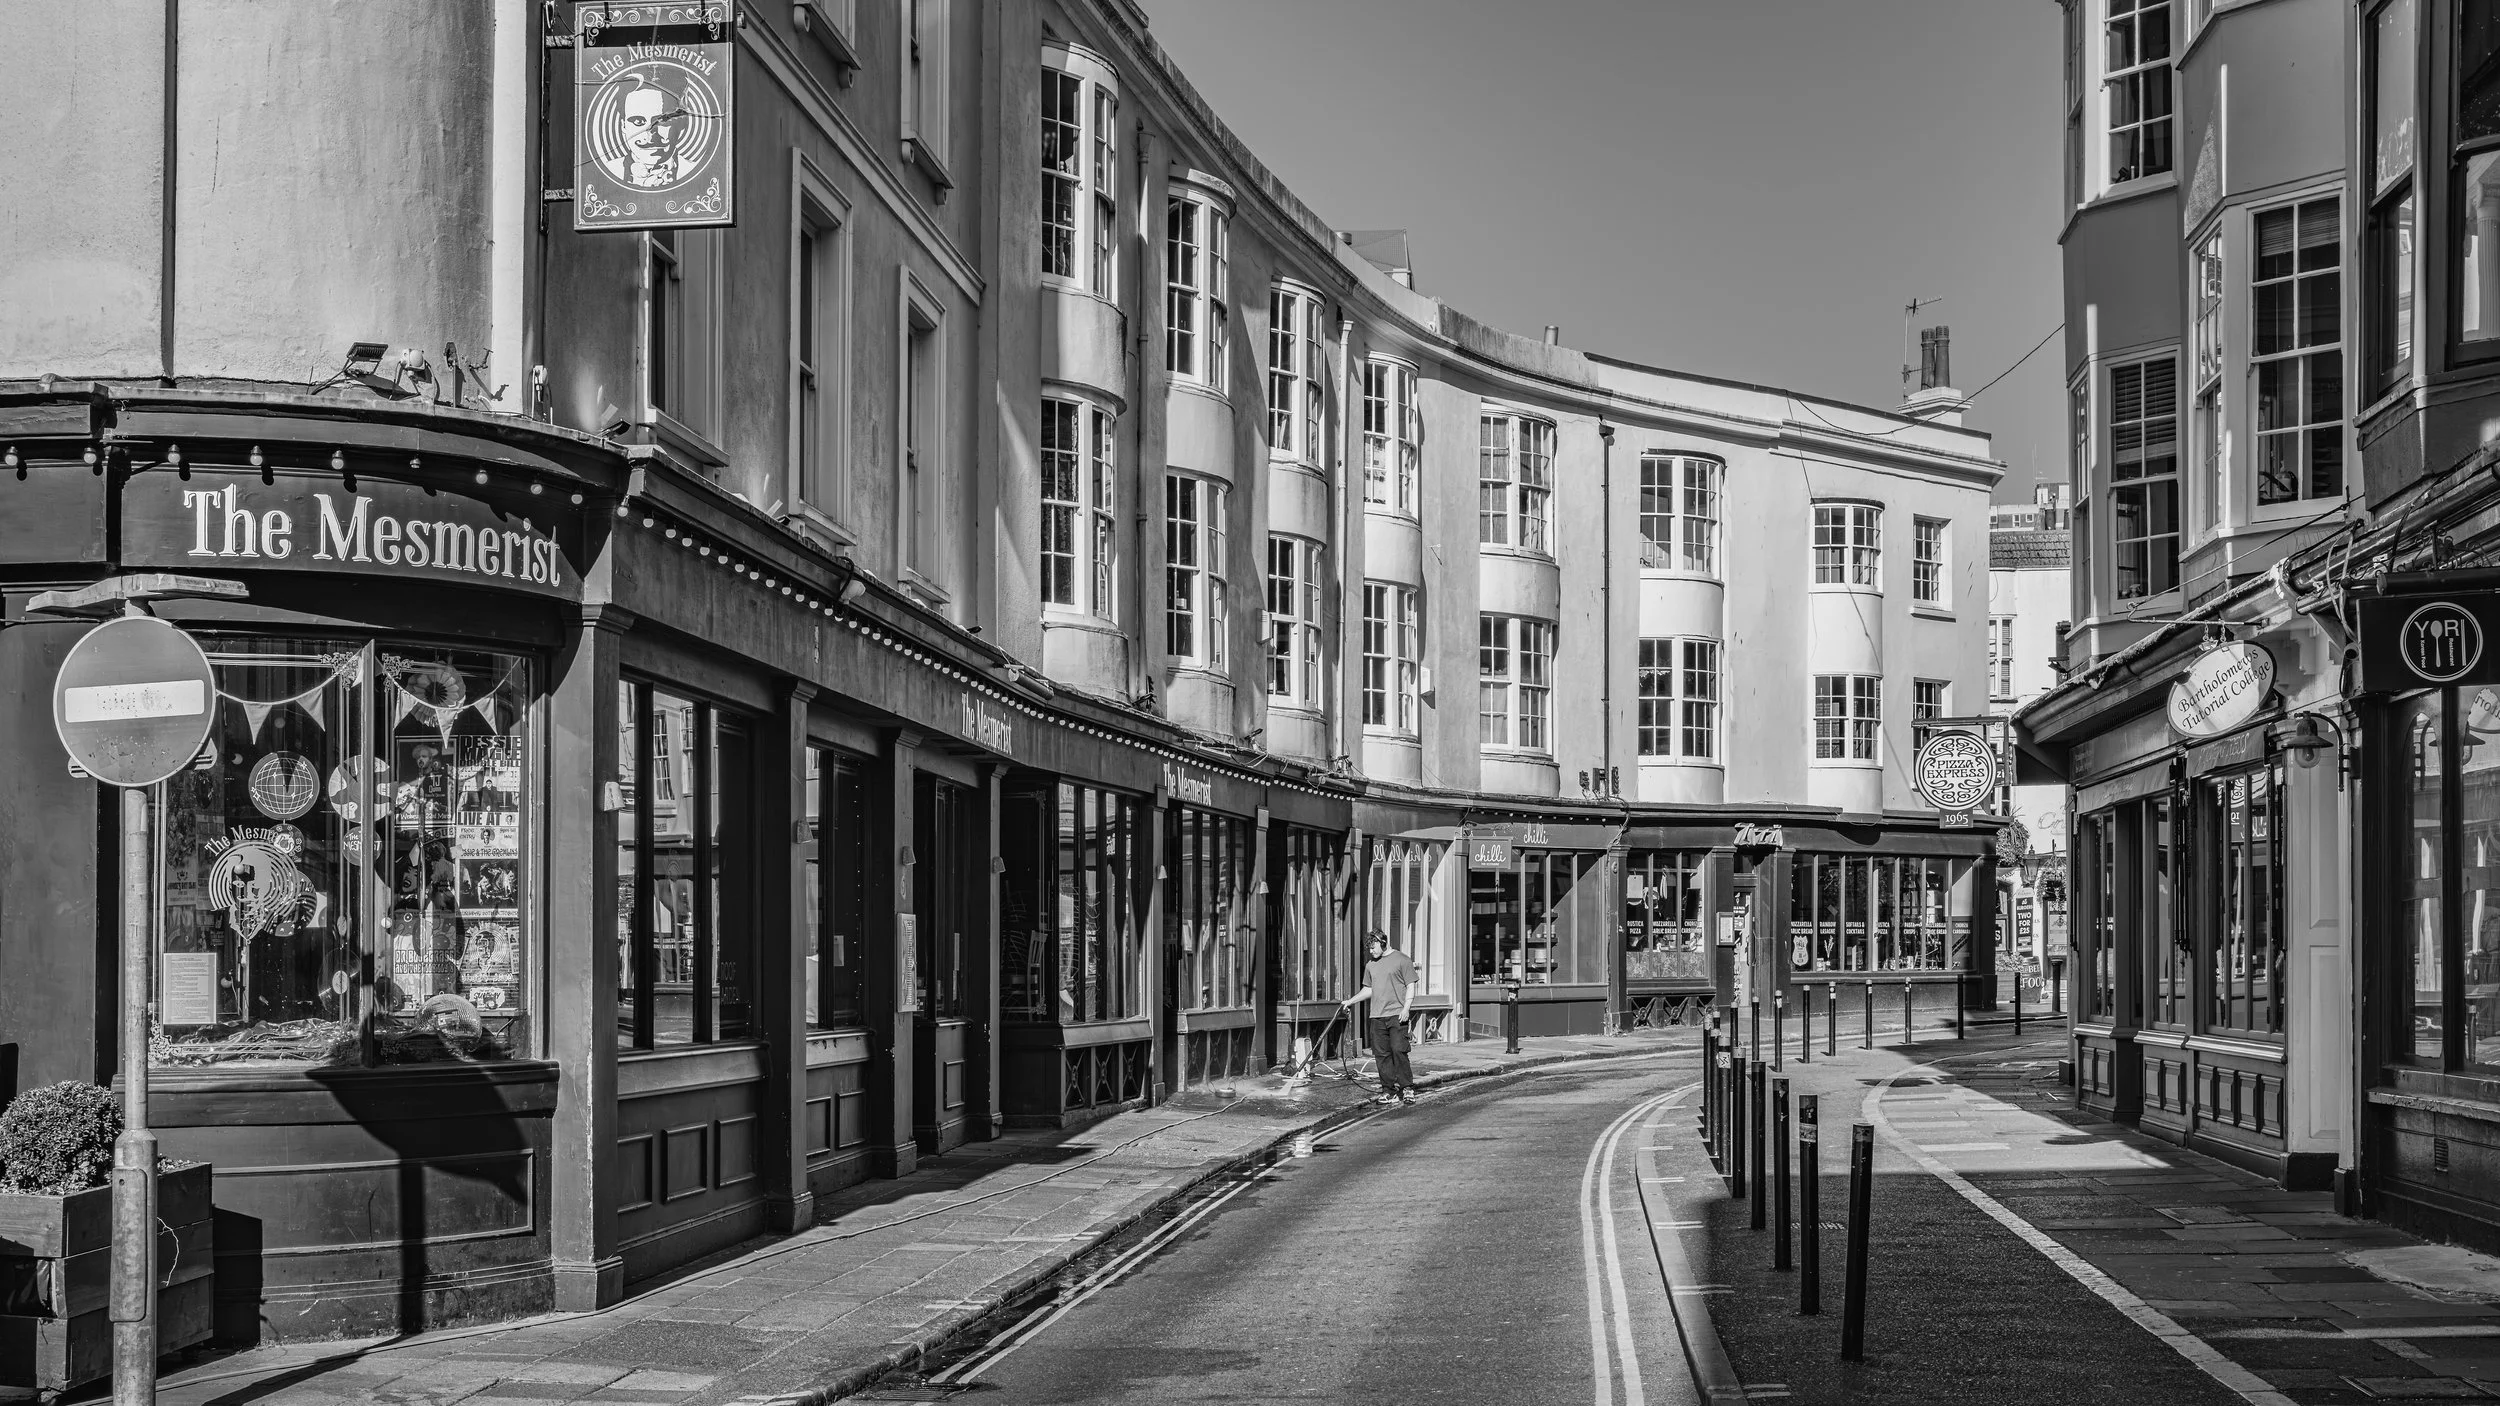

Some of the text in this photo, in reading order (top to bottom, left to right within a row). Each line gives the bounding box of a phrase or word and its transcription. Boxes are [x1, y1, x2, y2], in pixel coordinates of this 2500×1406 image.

[591, 41, 717, 80] The Mesmerist
[183, 482, 560, 588] The Mesmerist
[2178, 649, 2259, 713] Bartholomews
[2182, 661, 2271, 731] Tutorial College
[961, 690, 1012, 755] The Mesmerist
[1927, 768, 1985, 779] EXPRESS
[1937, 760, 1974, 769] PIZZA
[1163, 760, 1211, 807] The Mesmerist
[458, 812, 502, 825] LIVE AT
[1945, 811, 1969, 825] 1965
[1523, 822, 1549, 845] chilli
[204, 835, 232, 857] The
[1475, 843, 1507, 862] chilli
[2019, 920, 2031, 928] FOR
